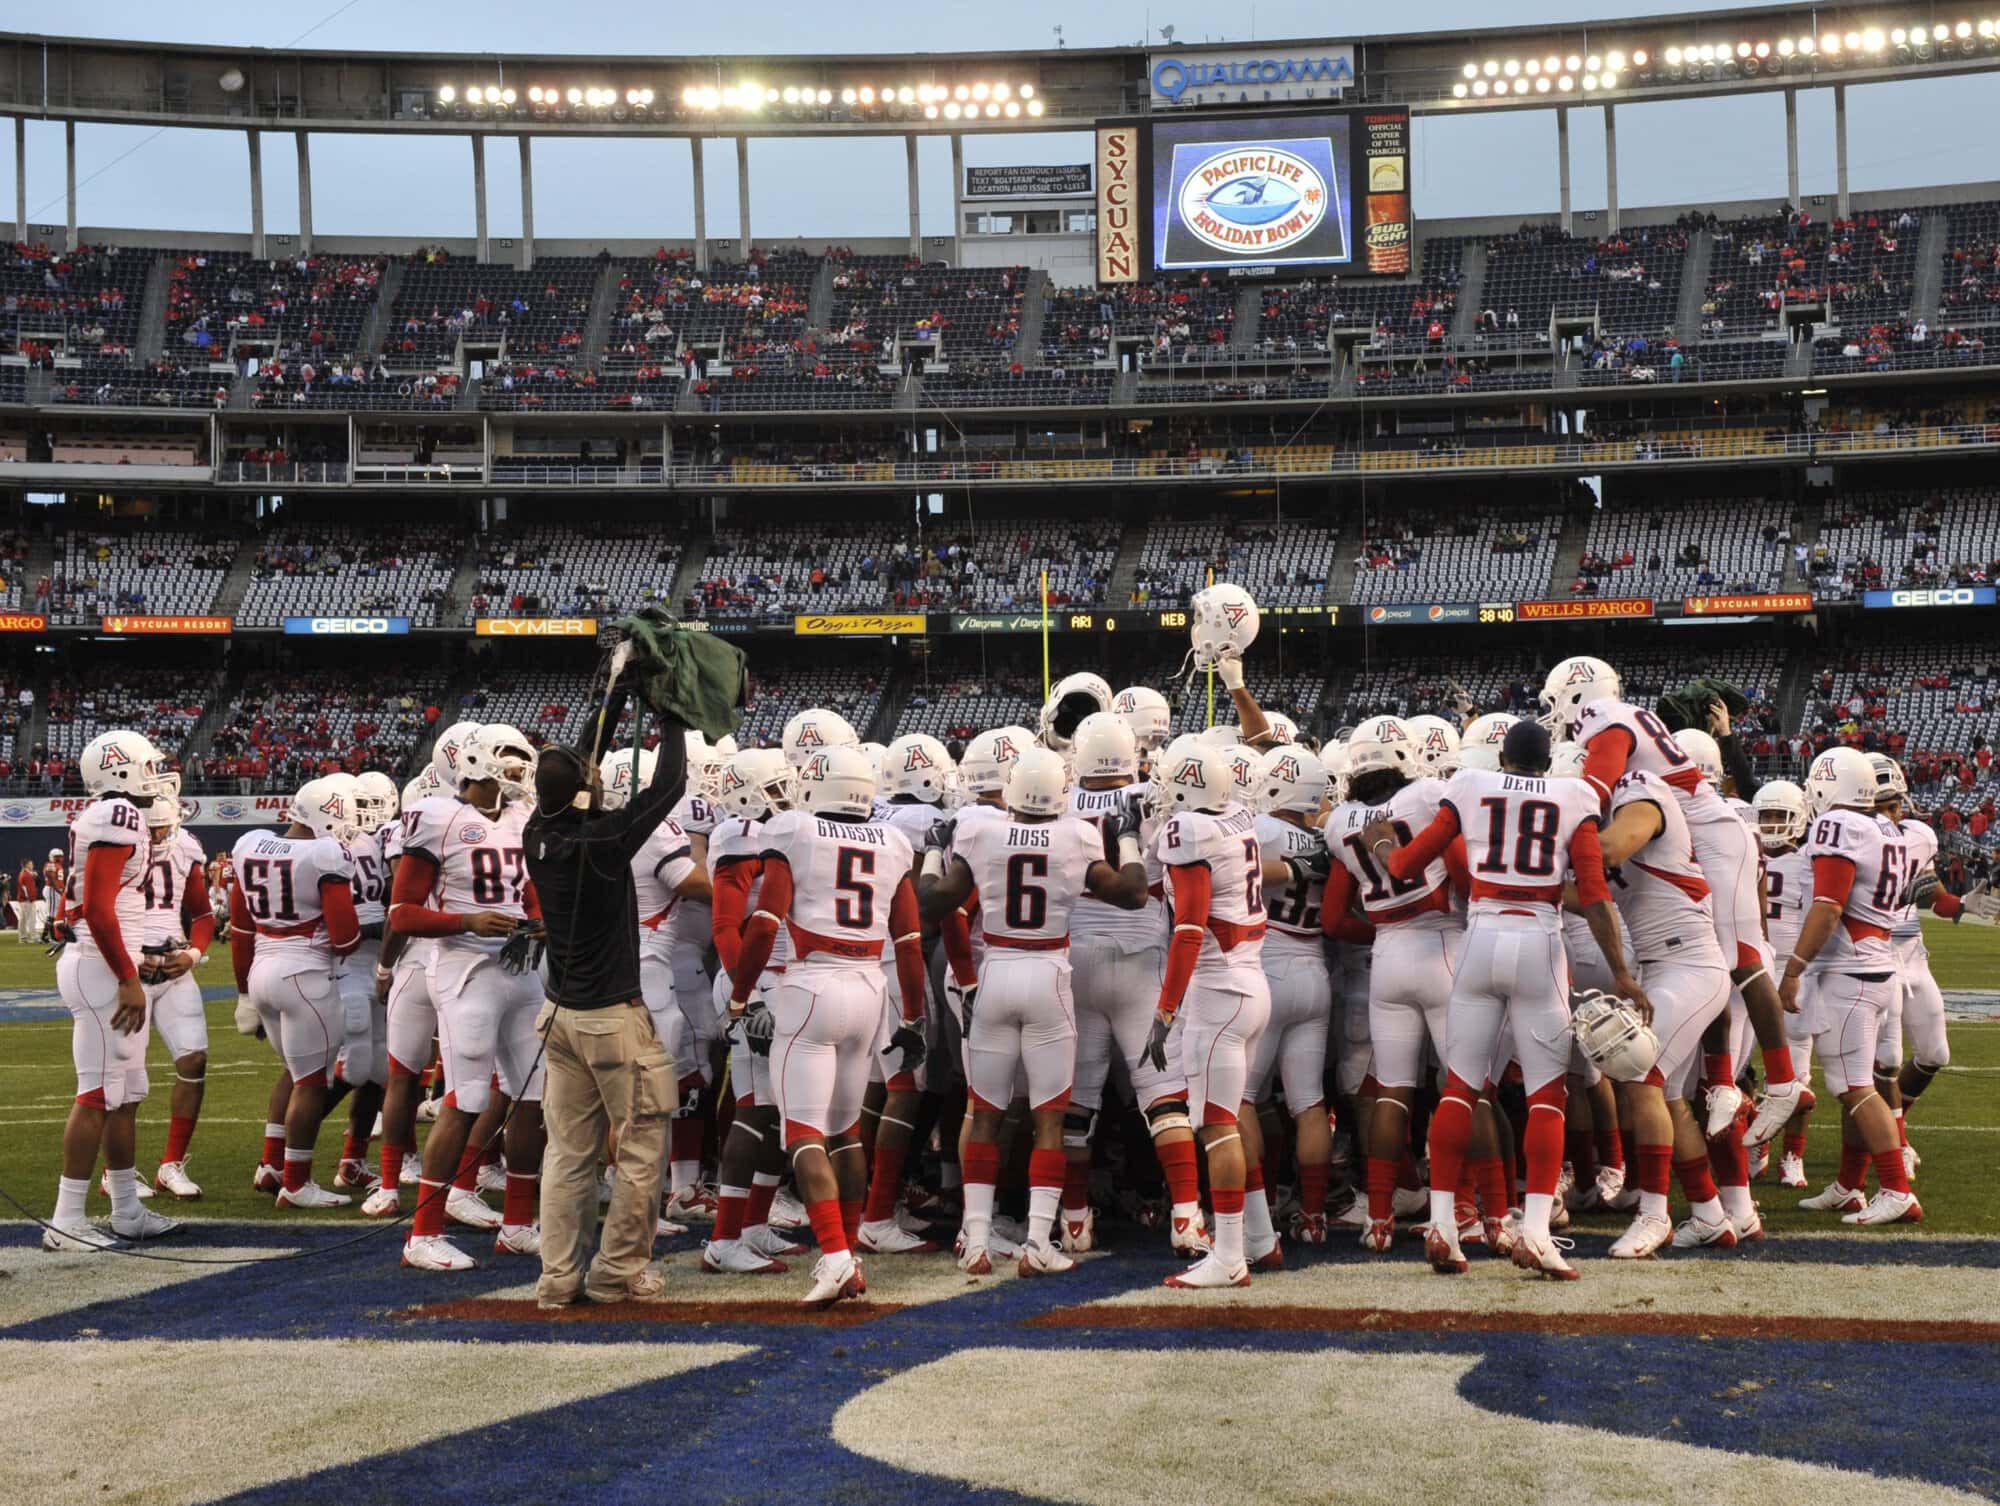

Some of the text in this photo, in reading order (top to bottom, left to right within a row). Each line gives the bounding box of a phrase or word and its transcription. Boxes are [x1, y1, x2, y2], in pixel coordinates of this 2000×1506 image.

[1152, 56, 1354, 104] QUALCOMM
[1196, 87, 1340, 103] STADIUM
[1201, 155, 1303, 186] PACIFIC LIFE
[1106, 134, 1131, 278] SYCUAN
[1193, 211, 1313, 245] HOLIDAY BOWL
[1367, 231, 1409, 243] LIGHT
[1372, 223, 1405, 234] BUD
[1714, 598, 1808, 609] SYCUAN RESORT
[1892, 588, 1974, 606] GEICO
[1161, 613, 1186, 626] NEB
[1387, 610, 1411, 619] pepsi
[1444, 609, 1469, 617] pepsi
[1479, 609, 1495, 622] 38
[1525, 604, 1583, 617] WELLS
[1589, 602, 1646, 615] FARGO
[133, 621, 228, 629] SYCUAN RESORT
[311, 618, 388, 633] GEICO
[489, 619, 584, 634] CYMER
[968, 618, 1003, 629] Degree
[1071, 615, 1092, 629] ARI
[1106, 618, 1115, 631] 0
[1566, 661, 1594, 685] A
[797, 723, 823, 746] A
[1381, 720, 1406, 743] A
[1427, 728, 1448, 751] A
[100, 742, 131, 769] A
[904, 744, 933, 772] A
[995, 736, 1019, 763] A
[802, 753, 827, 780] A
[1175, 758, 1206, 788] A
[1270, 755, 1296, 783] A
[1815, 757, 1837, 781] A
[722, 765, 744, 795] A
[1501, 775, 1547, 795] DEAN
[111, 804, 139, 831] 82
[320, 793, 345, 819] A
[817, 820, 885, 845] GRIGSBY
[1007, 828, 1050, 847] ROSS
[1167, 820, 1181, 848] 2
[1476, 796, 1560, 876] 18
[1816, 820, 1841, 848] 61
[471, 848, 525, 905] 87
[834, 846, 876, 930] 5
[1242, 837, 1263, 915] 2
[1872, 844, 1907, 911] 61
[243, 857, 300, 923] 51
[1005, 853, 1049, 930] 6
